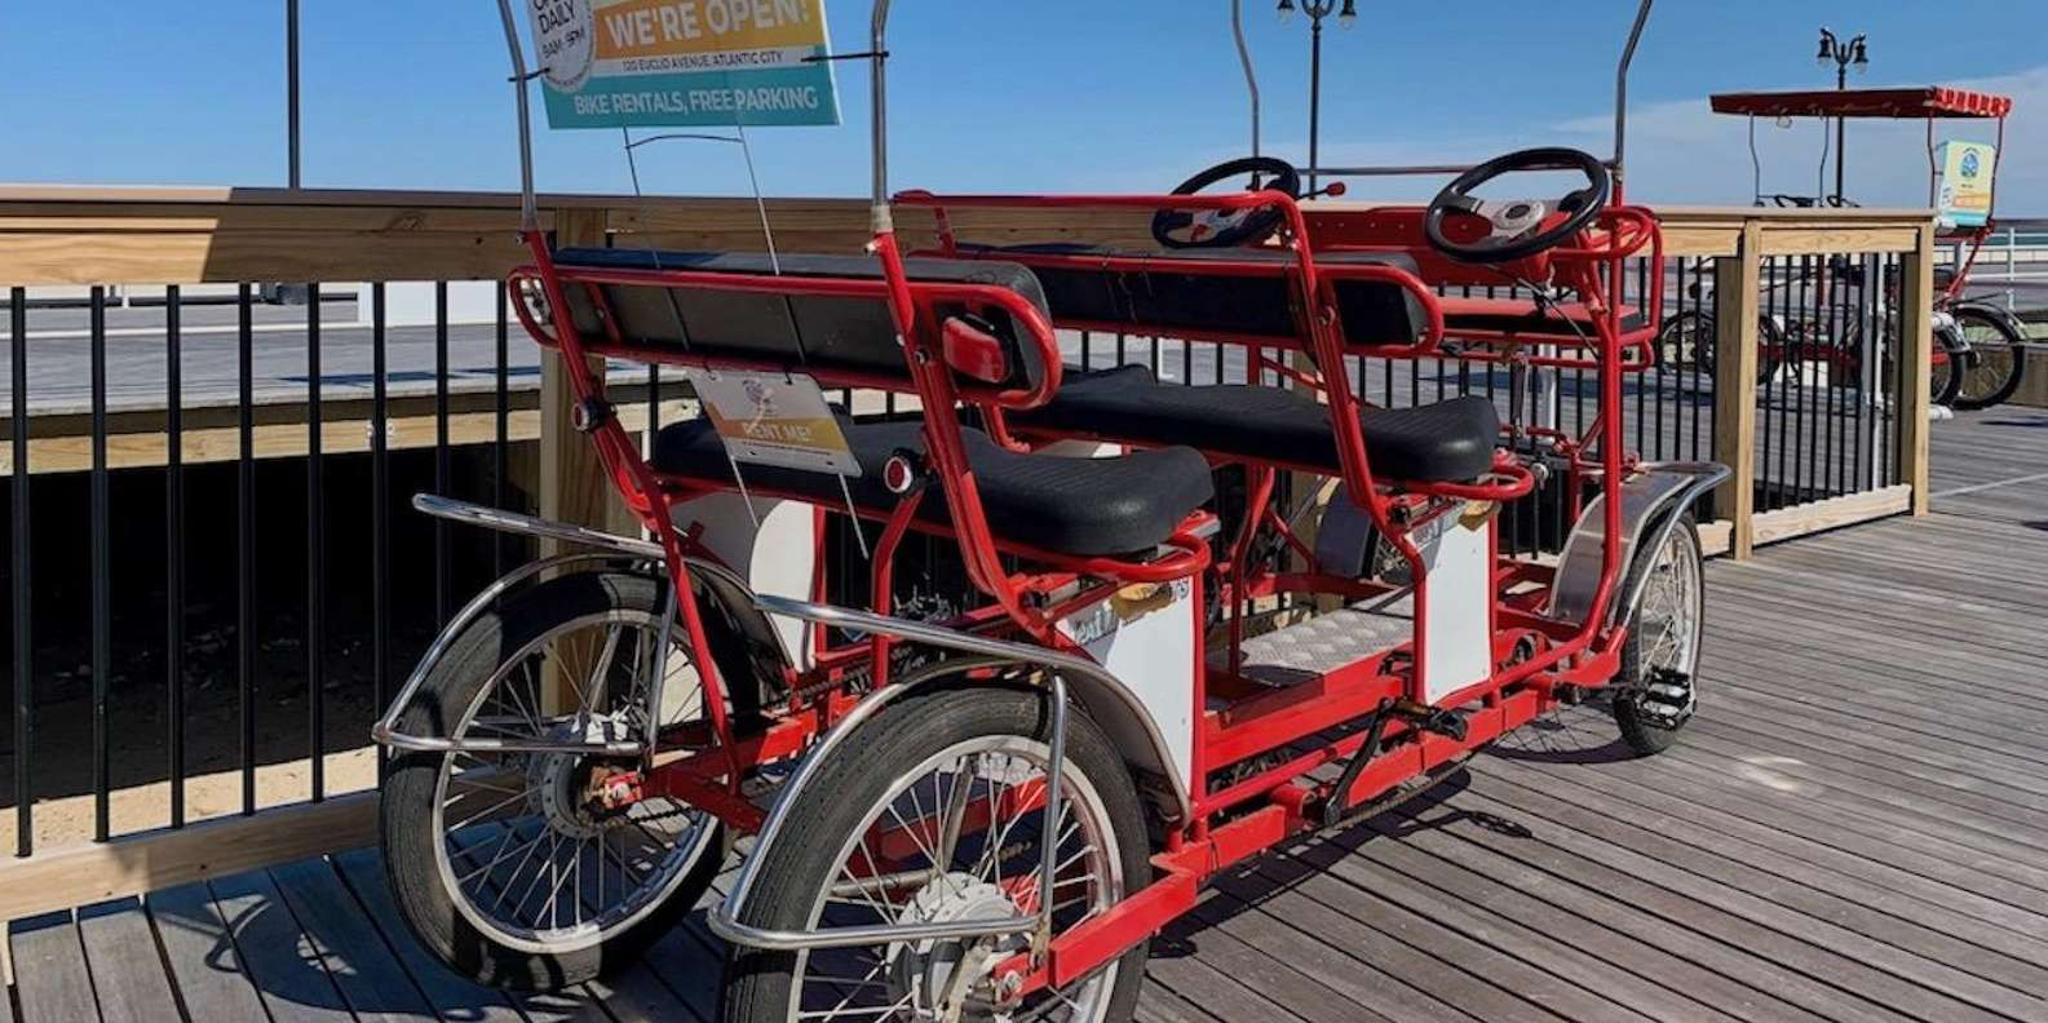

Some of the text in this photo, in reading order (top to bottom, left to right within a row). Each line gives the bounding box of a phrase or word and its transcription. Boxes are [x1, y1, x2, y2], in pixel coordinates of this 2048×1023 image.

[538, 0, 575, 34] DAILY
[604, 2, 702, 49] WE'RE
[574, 86, 818, 115] BIKE RENTALS, FREE PARKING
